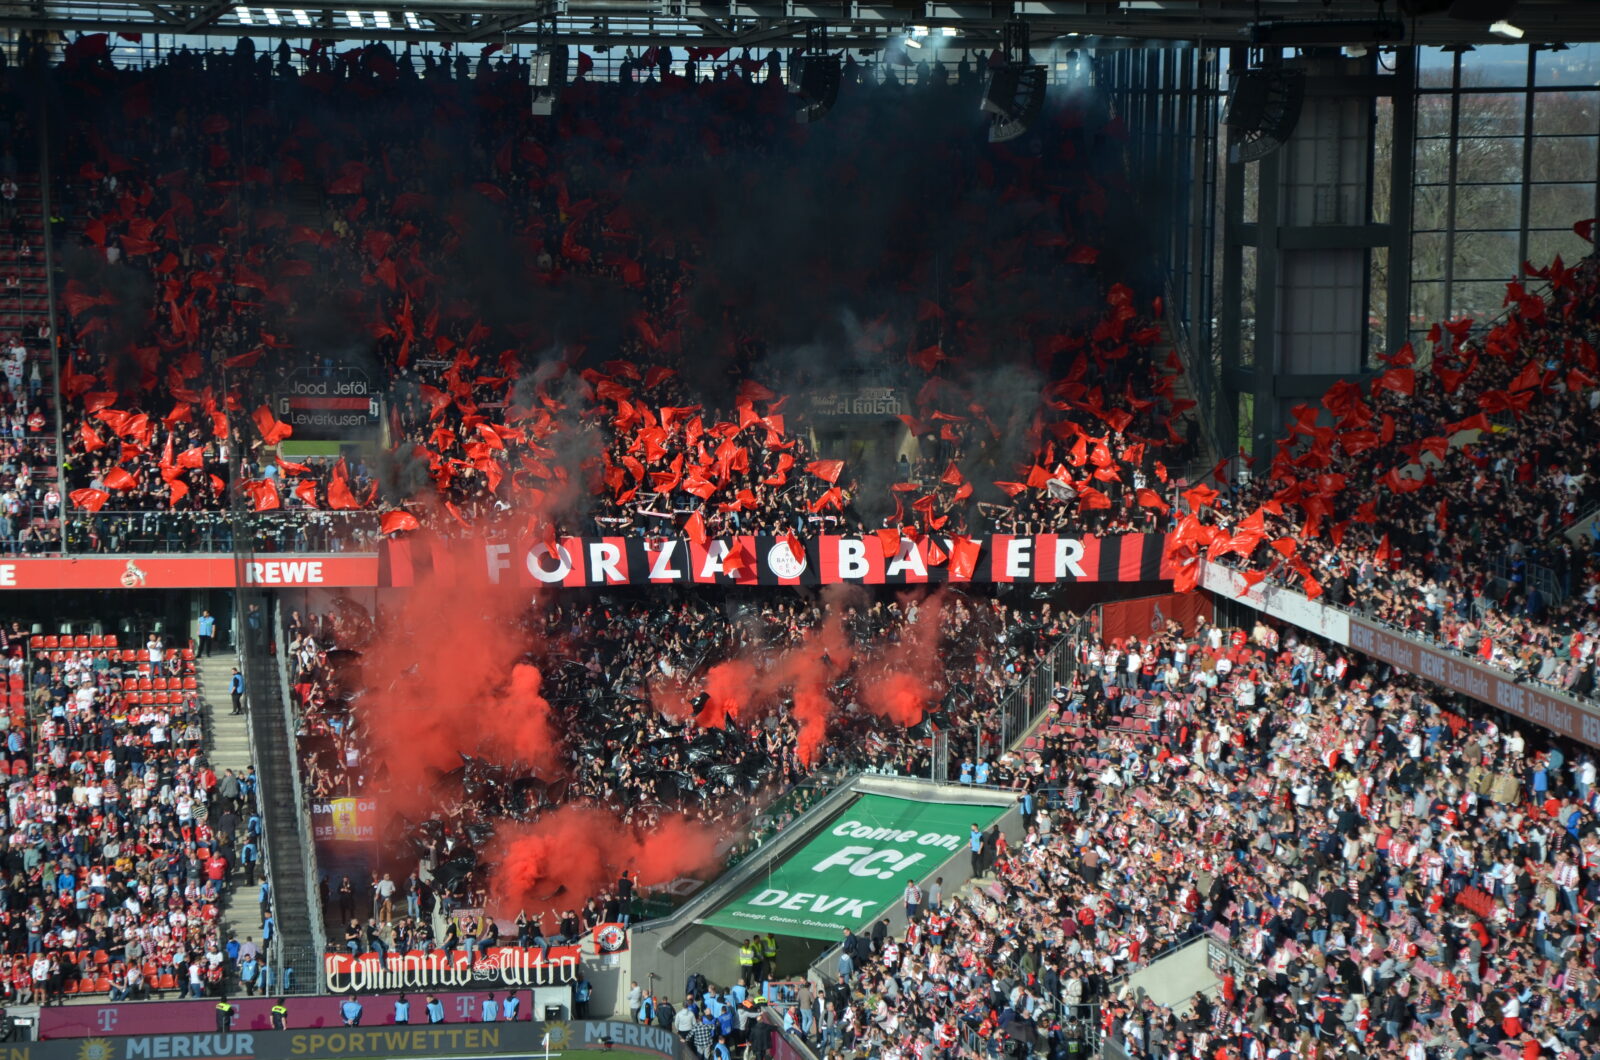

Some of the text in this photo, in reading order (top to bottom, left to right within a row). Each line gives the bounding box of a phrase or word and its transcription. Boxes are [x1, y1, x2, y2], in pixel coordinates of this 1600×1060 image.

[290, 380, 367, 395] Jood Jeföl
[290, 411, 367, 426] Leverkusen
[246, 561, 323, 583] REWE
[486, 538, 1088, 584] FORZA BAER
[1351, 623, 1375, 653] REWE
[1420, 650, 1446, 681] REWE
[1496, 680, 1525, 714] REWE
[313, 801, 376, 814] BAYER 04
[315, 825, 374, 836] BELGIUM
[832, 820, 962, 852] Come on,
[812, 845, 926, 880] FC!
[748, 888, 878, 919] DEVK
[326, 947, 578, 993] Commando Ultra
[126, 1033, 255, 1060] MERKUR
[291, 1028, 500, 1055] SPORTWETTEN
[584, 1021, 673, 1056] MERKUR
